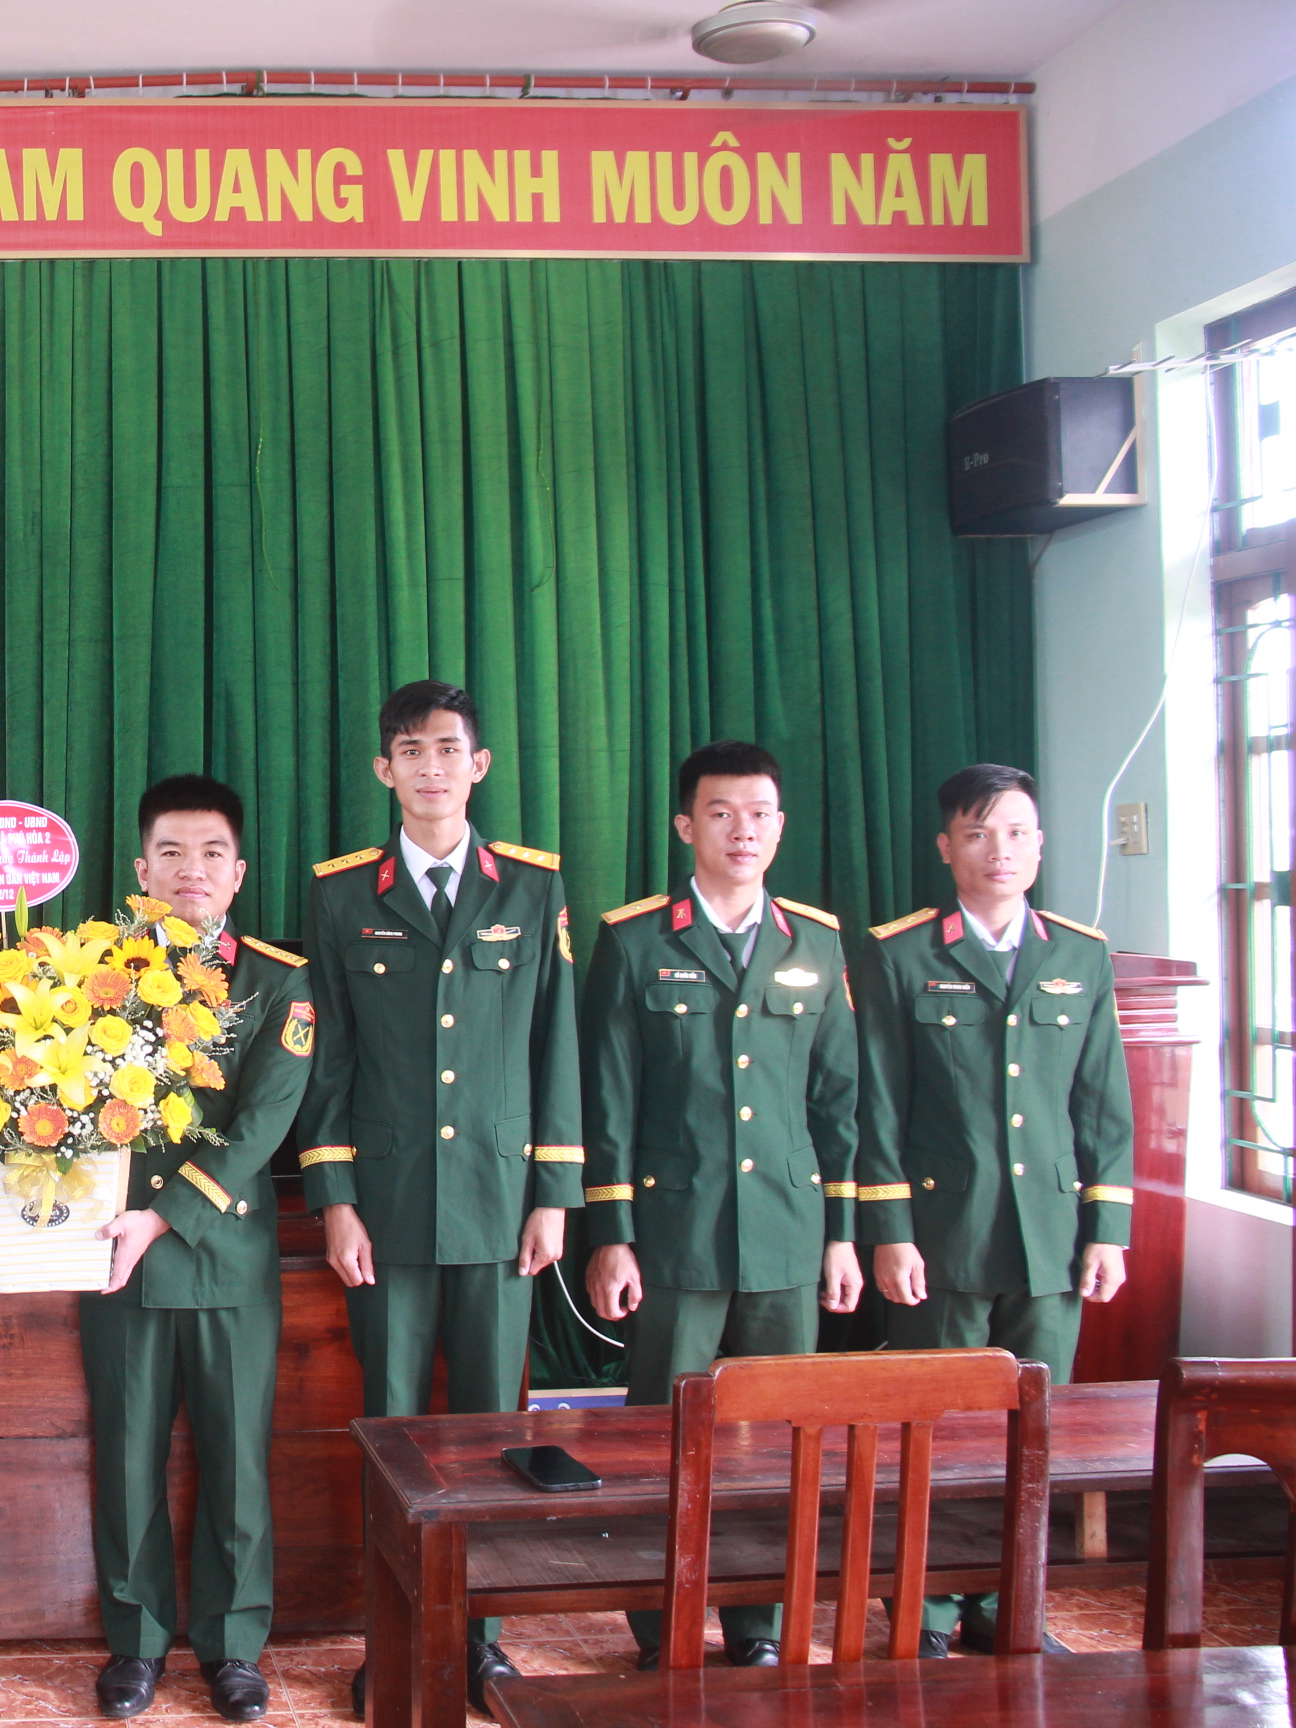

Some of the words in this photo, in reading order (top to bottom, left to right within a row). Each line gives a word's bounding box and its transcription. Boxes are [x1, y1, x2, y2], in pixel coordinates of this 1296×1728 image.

[112, 146, 365, 237] QUANG
[386, 147, 561, 223] VINH
[590, 131, 803, 226] MUÔN
[830, 137, 990, 226] NĂM
[24, 816, 48, 828] UBND
[26, 829, 44, 844] HÒA
[45, 832, 51, 844] 2
[16, 849, 49, 864] Thành
[50, 848, 72, 865] Lập
[23, 870, 41, 886] VIỆT
[41, 872, 61, 884] NAM
